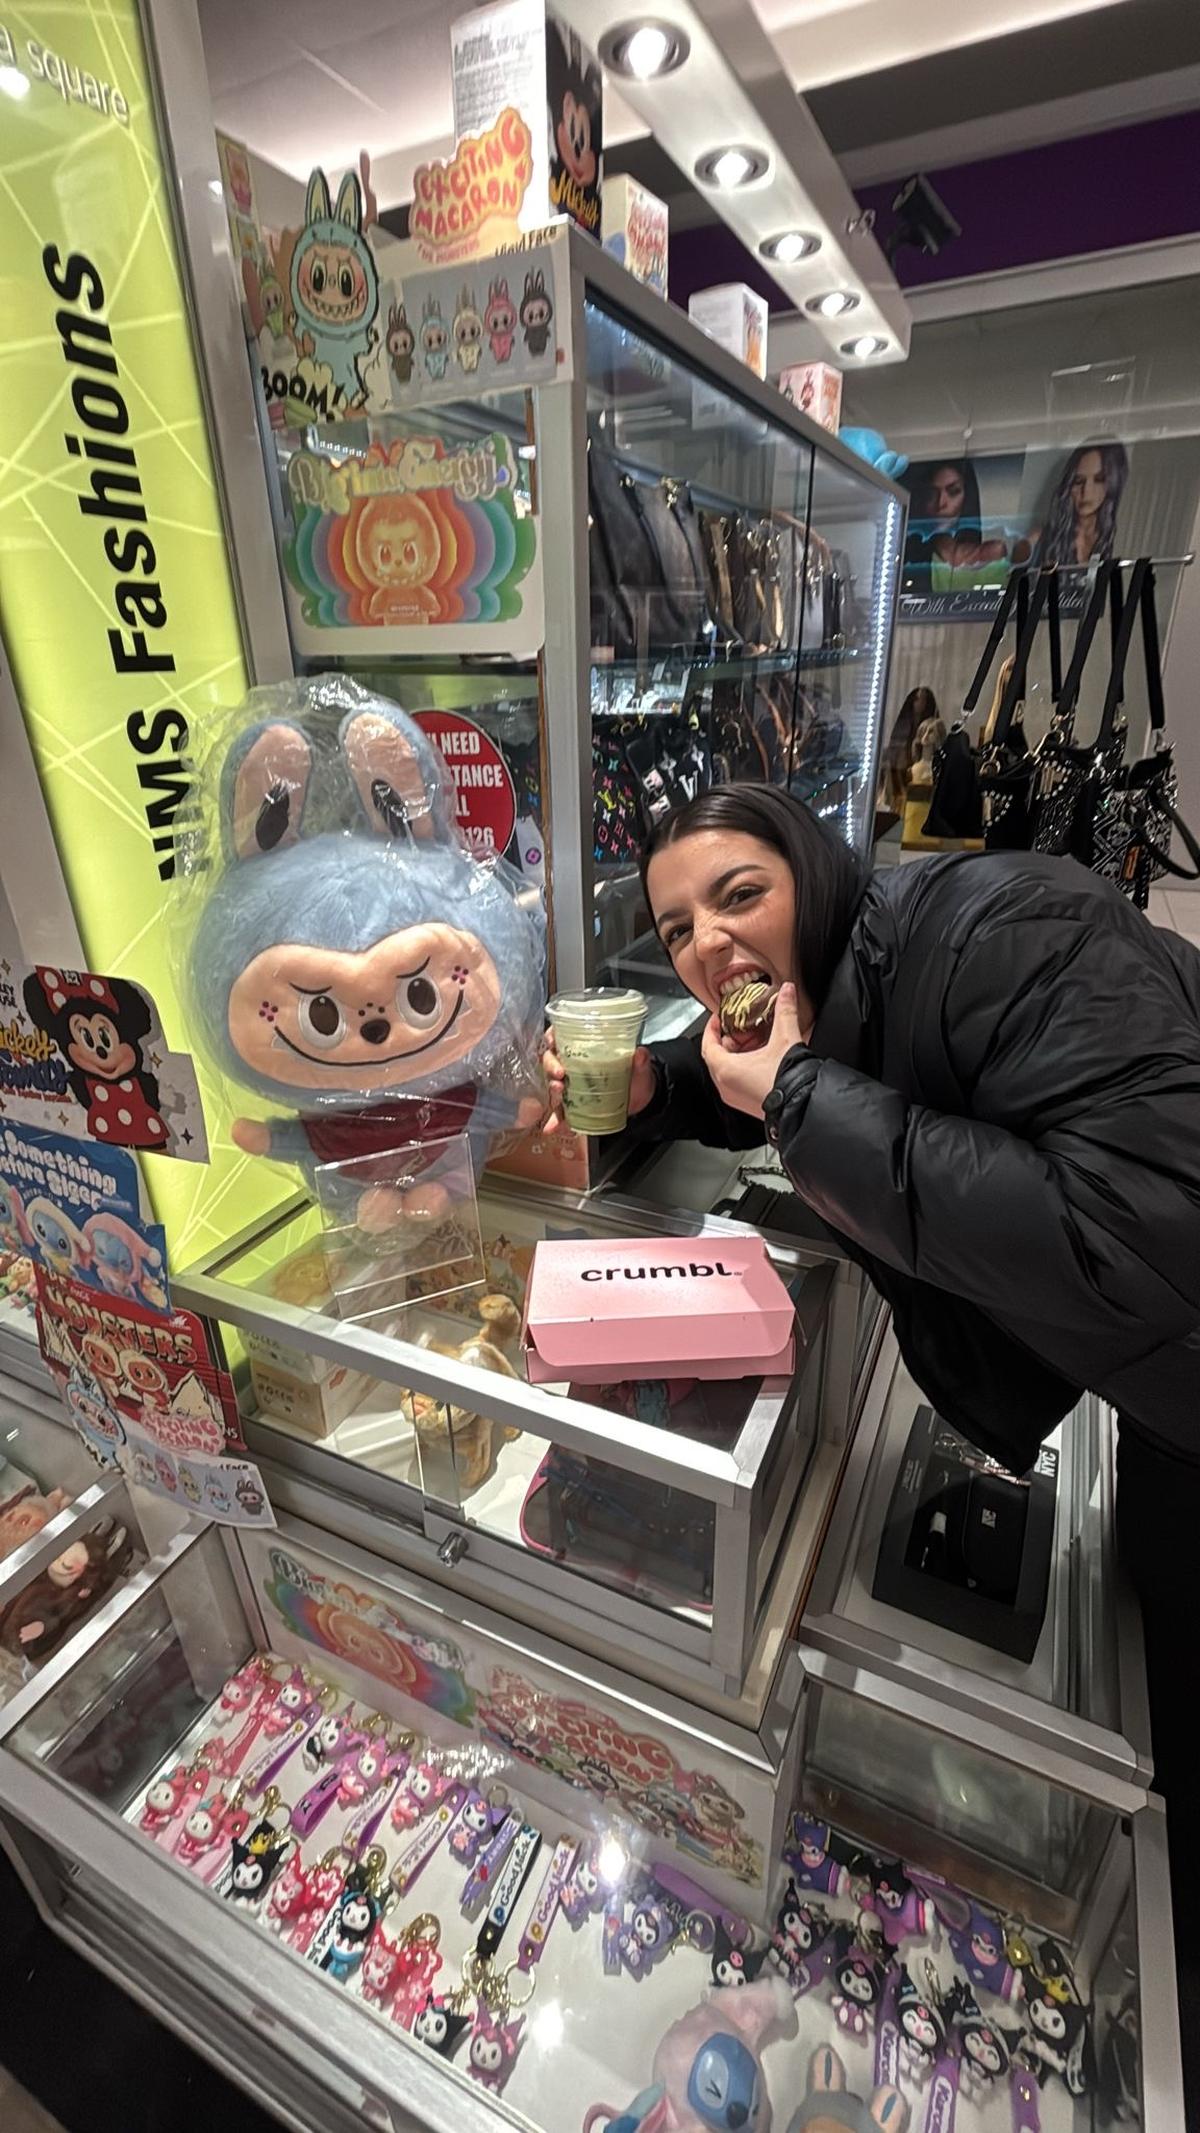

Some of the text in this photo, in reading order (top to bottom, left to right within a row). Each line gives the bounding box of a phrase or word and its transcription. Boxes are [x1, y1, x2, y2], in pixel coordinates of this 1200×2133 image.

[27, 40, 130, 128] square
[419, 114, 526, 206] EXCITING
[414, 177, 519, 239] MACARON
[528, 226, 558, 249] Face
[42, 243, 176, 674] Fashions
[441, 731, 480, 755] NEED
[452, 764, 504, 788] TANCE
[0, 1018, 58, 1062] ickey
[0, 1154, 46, 1185] efore
[46, 1168, 104, 1212] Sleep
[4, 1130, 117, 1197] Something
[46, 1284, 198, 1364] MONSTERS
[1039, 1450, 1057, 1478] NYC
